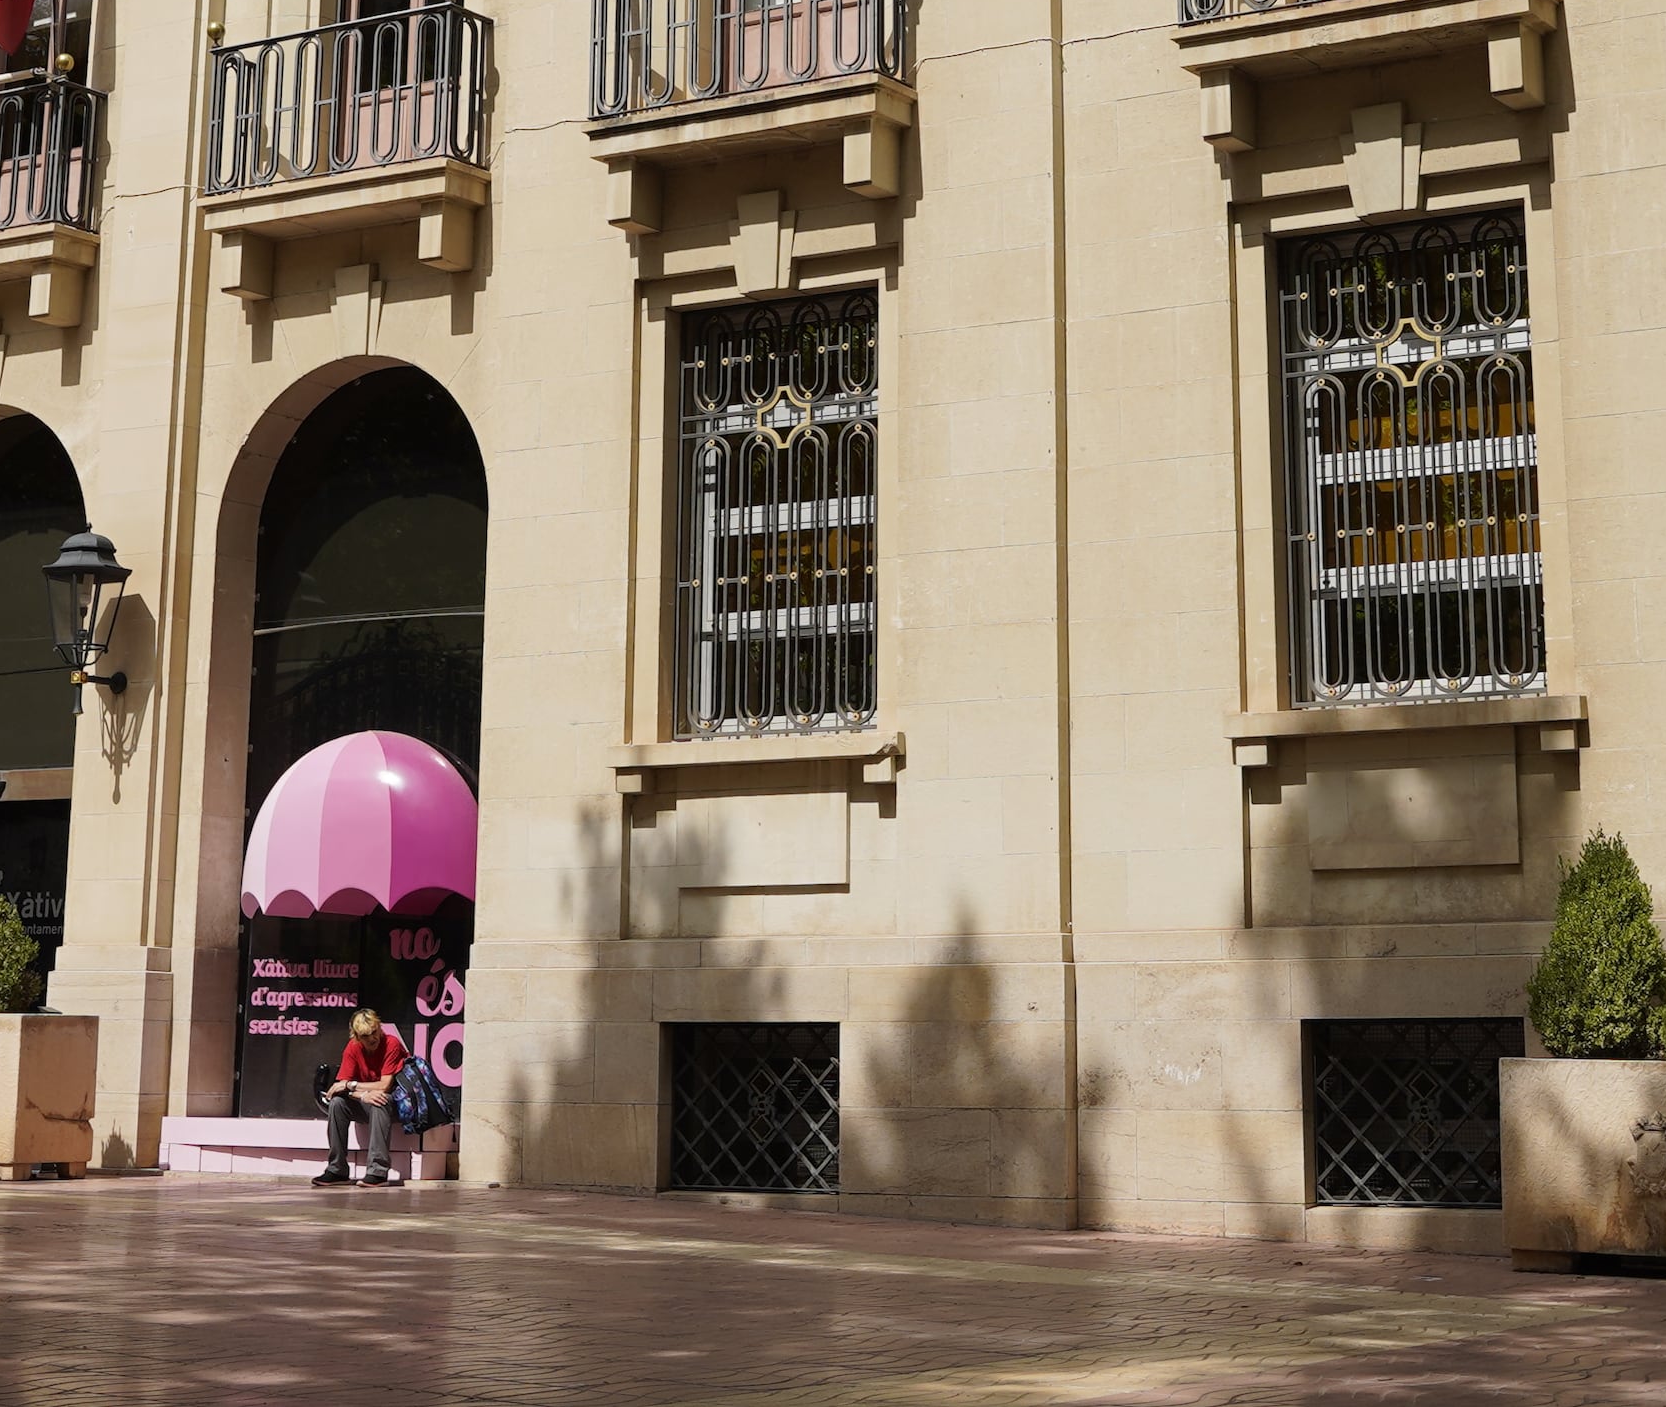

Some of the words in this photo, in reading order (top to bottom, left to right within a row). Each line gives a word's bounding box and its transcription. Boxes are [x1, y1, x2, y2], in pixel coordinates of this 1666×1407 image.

[6, 891, 63, 918] Xàtiv
[389, 927, 441, 960] no
[252, 958, 311, 978] Xàtiva
[313, 959, 359, 979] lliure
[251, 987, 358, 1011] d'agressions
[416, 958, 465, 1017] és
[249, 1015, 319, 1035] sexistes
